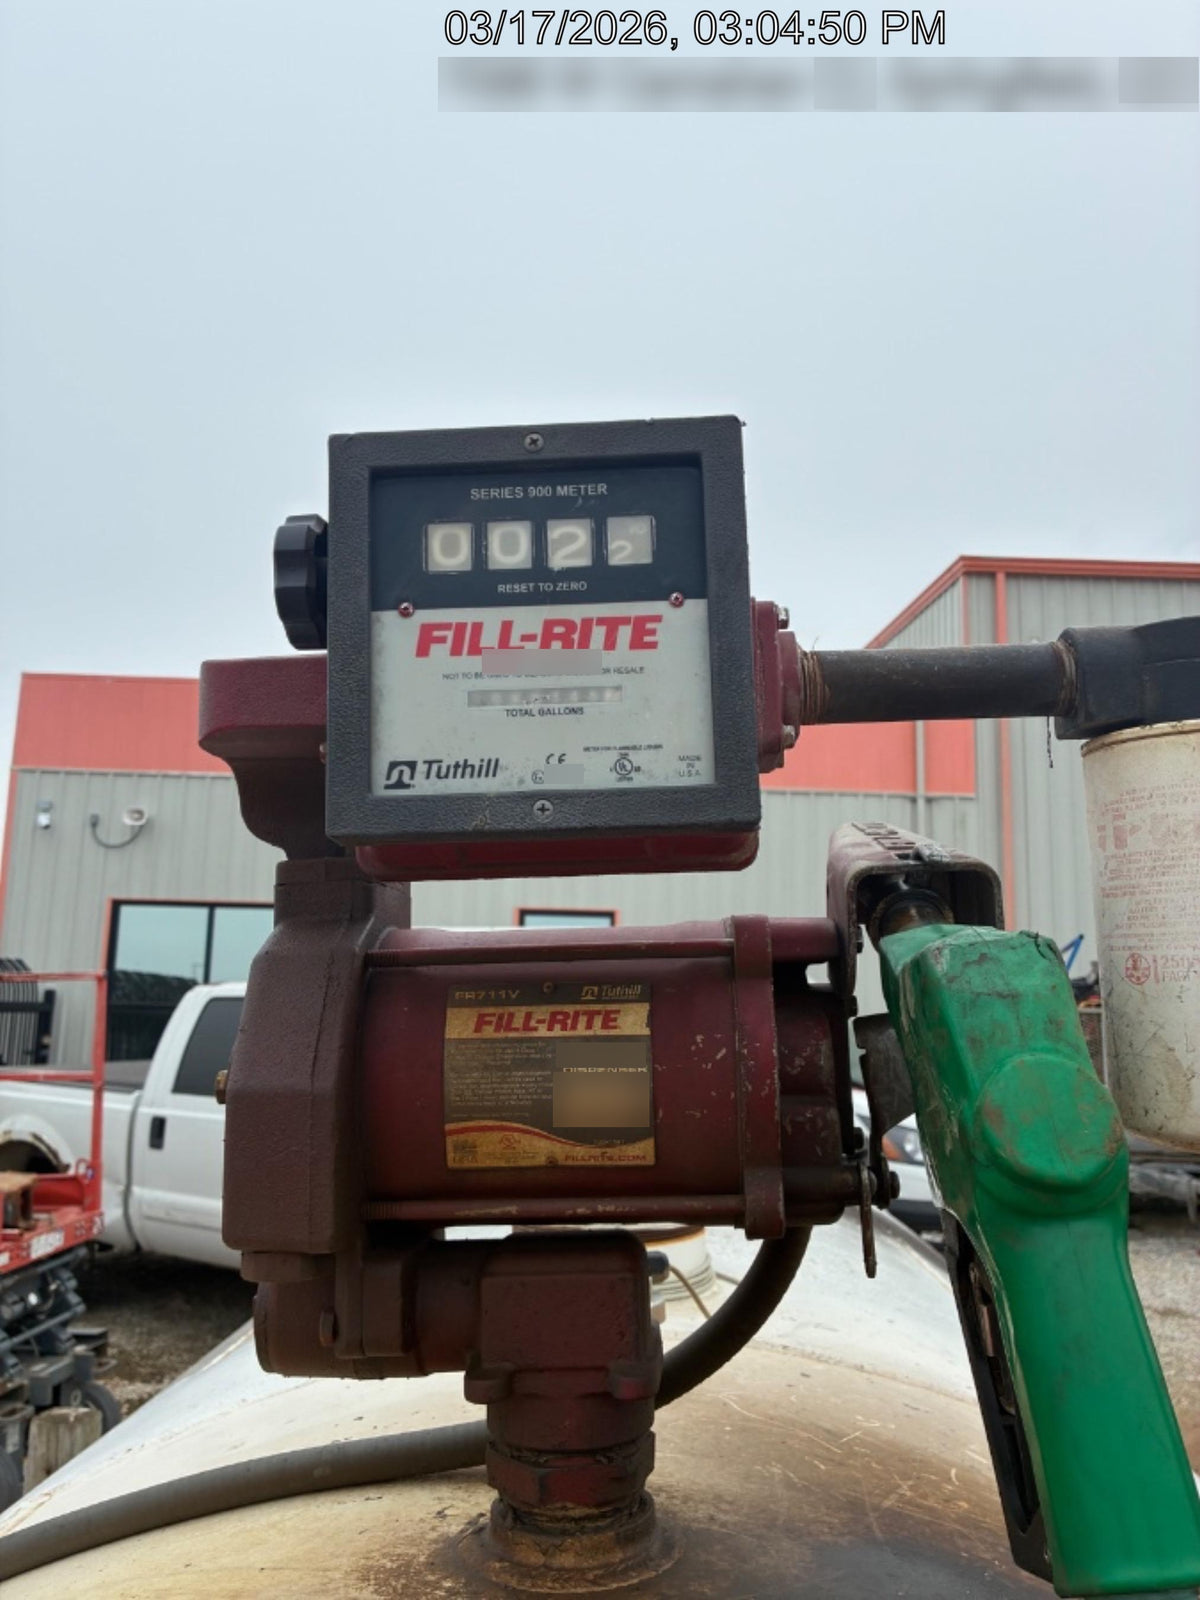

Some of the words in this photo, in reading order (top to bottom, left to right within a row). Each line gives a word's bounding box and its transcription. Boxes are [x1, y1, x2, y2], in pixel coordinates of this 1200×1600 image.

[470, 487, 524, 500] SERIES
[527, 485, 552, 497] 900
[556, 483, 608, 497] METER
[497, 582, 535, 593] RESET
[537, 582, 554, 592] TO
[556, 580, 588, 591] ZERO
[415, 614, 663, 659] FILL-RITE
[505, 707, 535, 718] TOTAL
[538, 706, 585, 717] GALLONS
[423, 757, 500, 780] Tuthill
[473, 1009, 622, 1034] FILL-RITE
